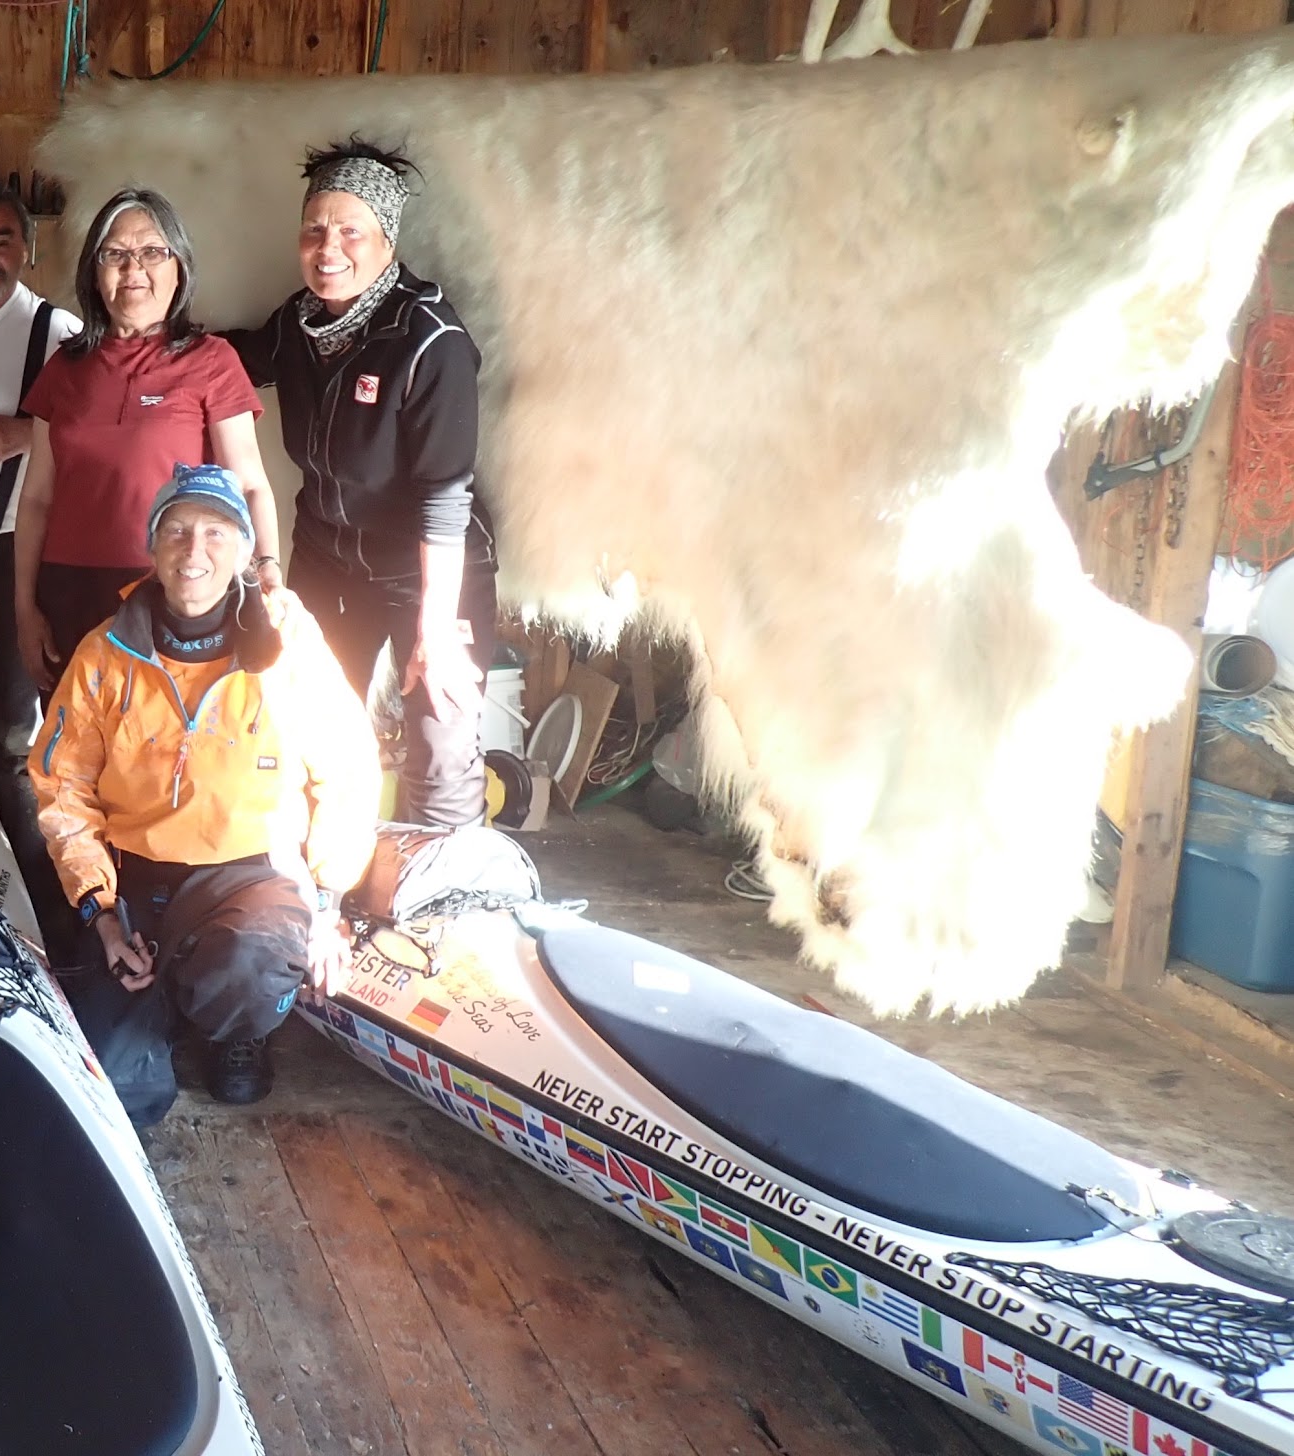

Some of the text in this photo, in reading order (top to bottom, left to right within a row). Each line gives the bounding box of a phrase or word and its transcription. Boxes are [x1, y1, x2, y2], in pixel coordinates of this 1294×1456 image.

[506, 1011, 542, 1042] Love
[532, 1069, 605, 1116] NEVER
[604, 1104, 681, 1158] START
[679, 1141, 808, 1218] STOPPING
[832, 1216, 933, 1279] NEVER
[937, 1267, 1025, 1318] STOP
[1029, 1310, 1214, 1413] STARTING
